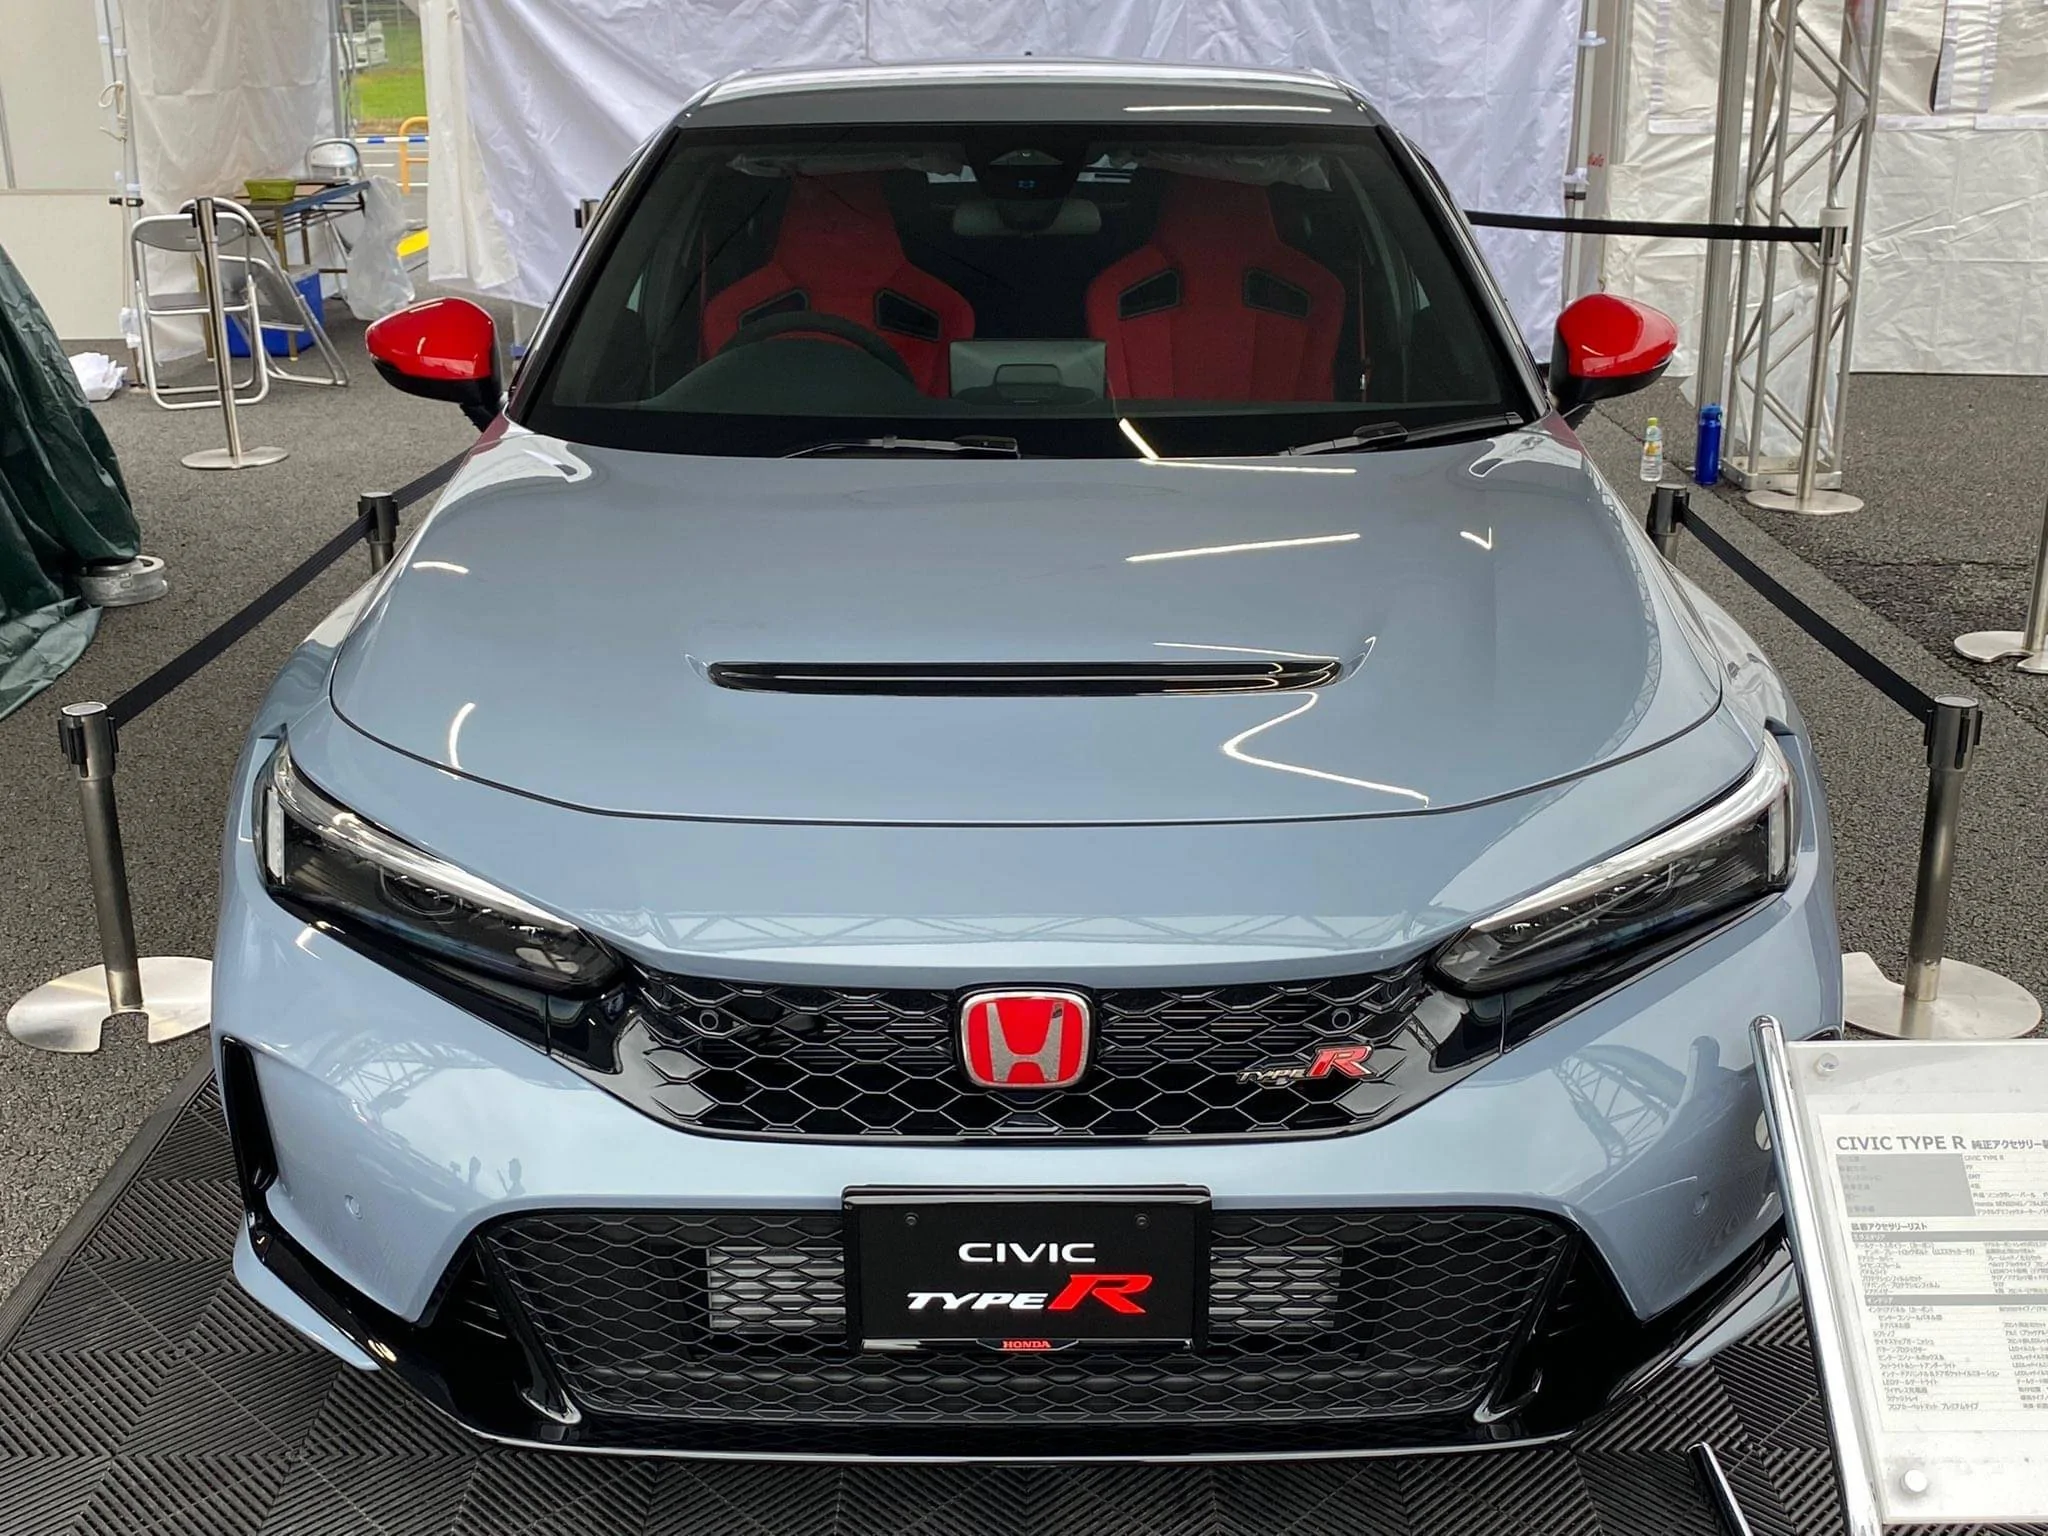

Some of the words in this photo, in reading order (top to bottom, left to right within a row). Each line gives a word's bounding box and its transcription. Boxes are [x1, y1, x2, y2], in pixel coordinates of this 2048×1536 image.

[1836, 1136, 1893, 1150] CIVIC
[1896, 1136, 1947, 1150] TYPE
[1951, 1136, 1967, 1150] R
[958, 1243, 1096, 1263] CIVIC
[907, 1292, 1049, 1310] TYPE
[1047, 1274, 1153, 1313] R
[1003, 1341, 1051, 1349] HONDA
